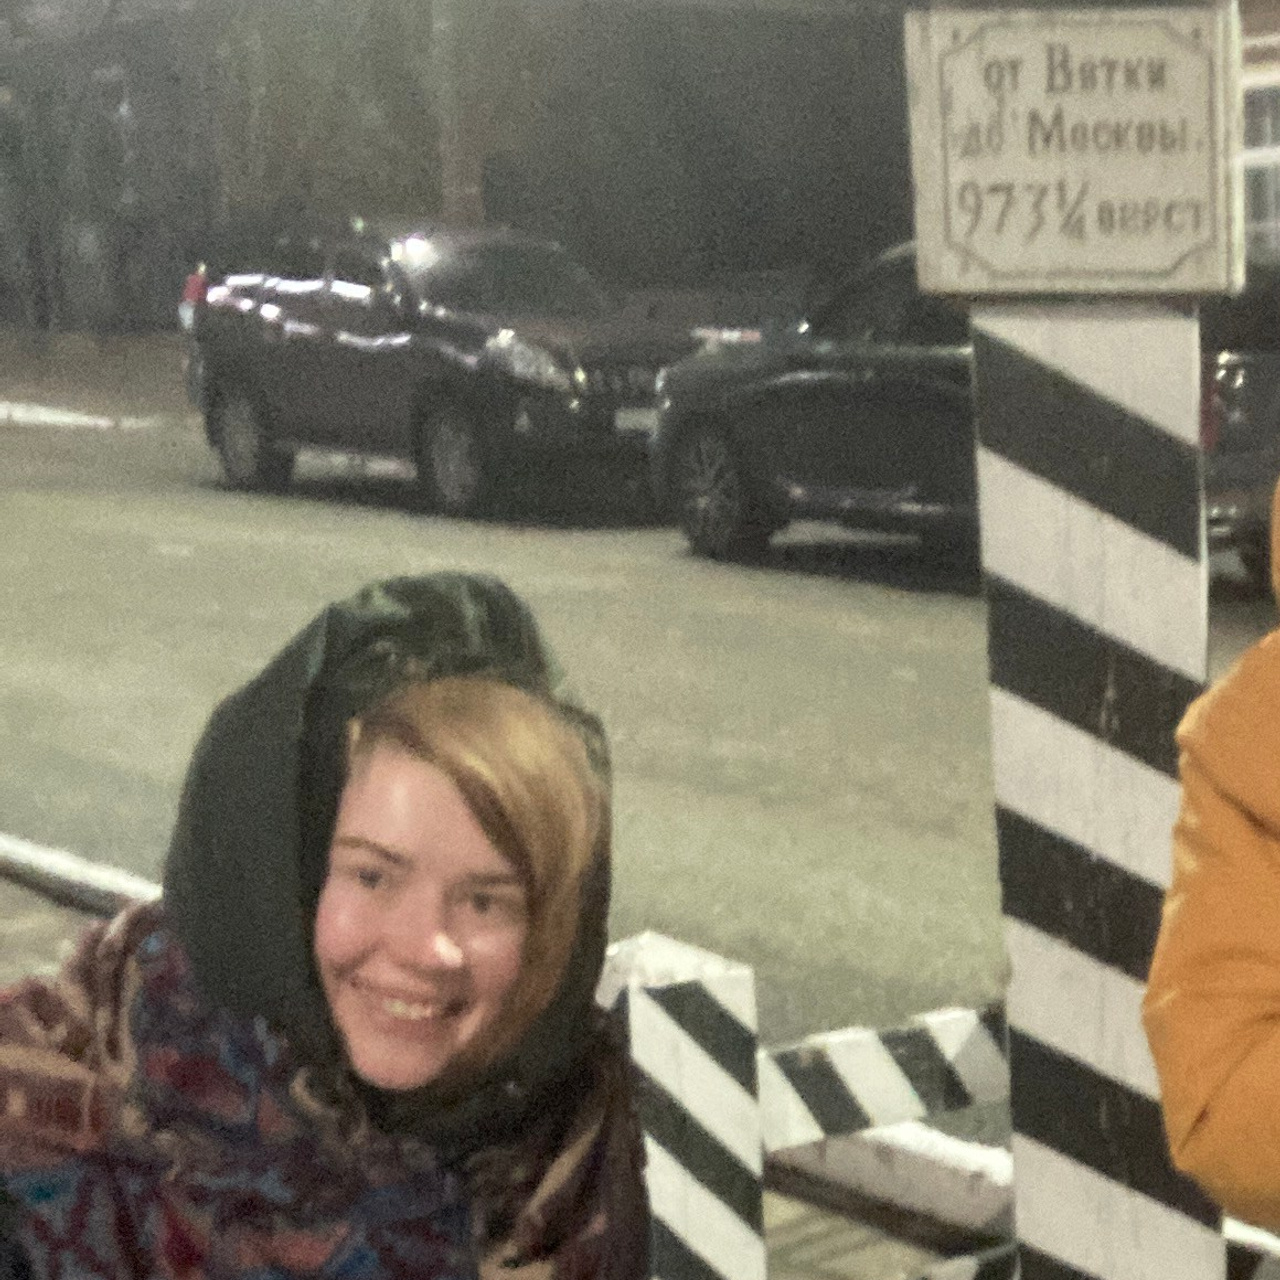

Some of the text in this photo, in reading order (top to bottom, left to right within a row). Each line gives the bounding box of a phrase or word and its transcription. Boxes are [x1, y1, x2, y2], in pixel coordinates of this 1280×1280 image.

[984, 43, 1168, 94] от Вятки
[960, 116, 1004, 158] до
